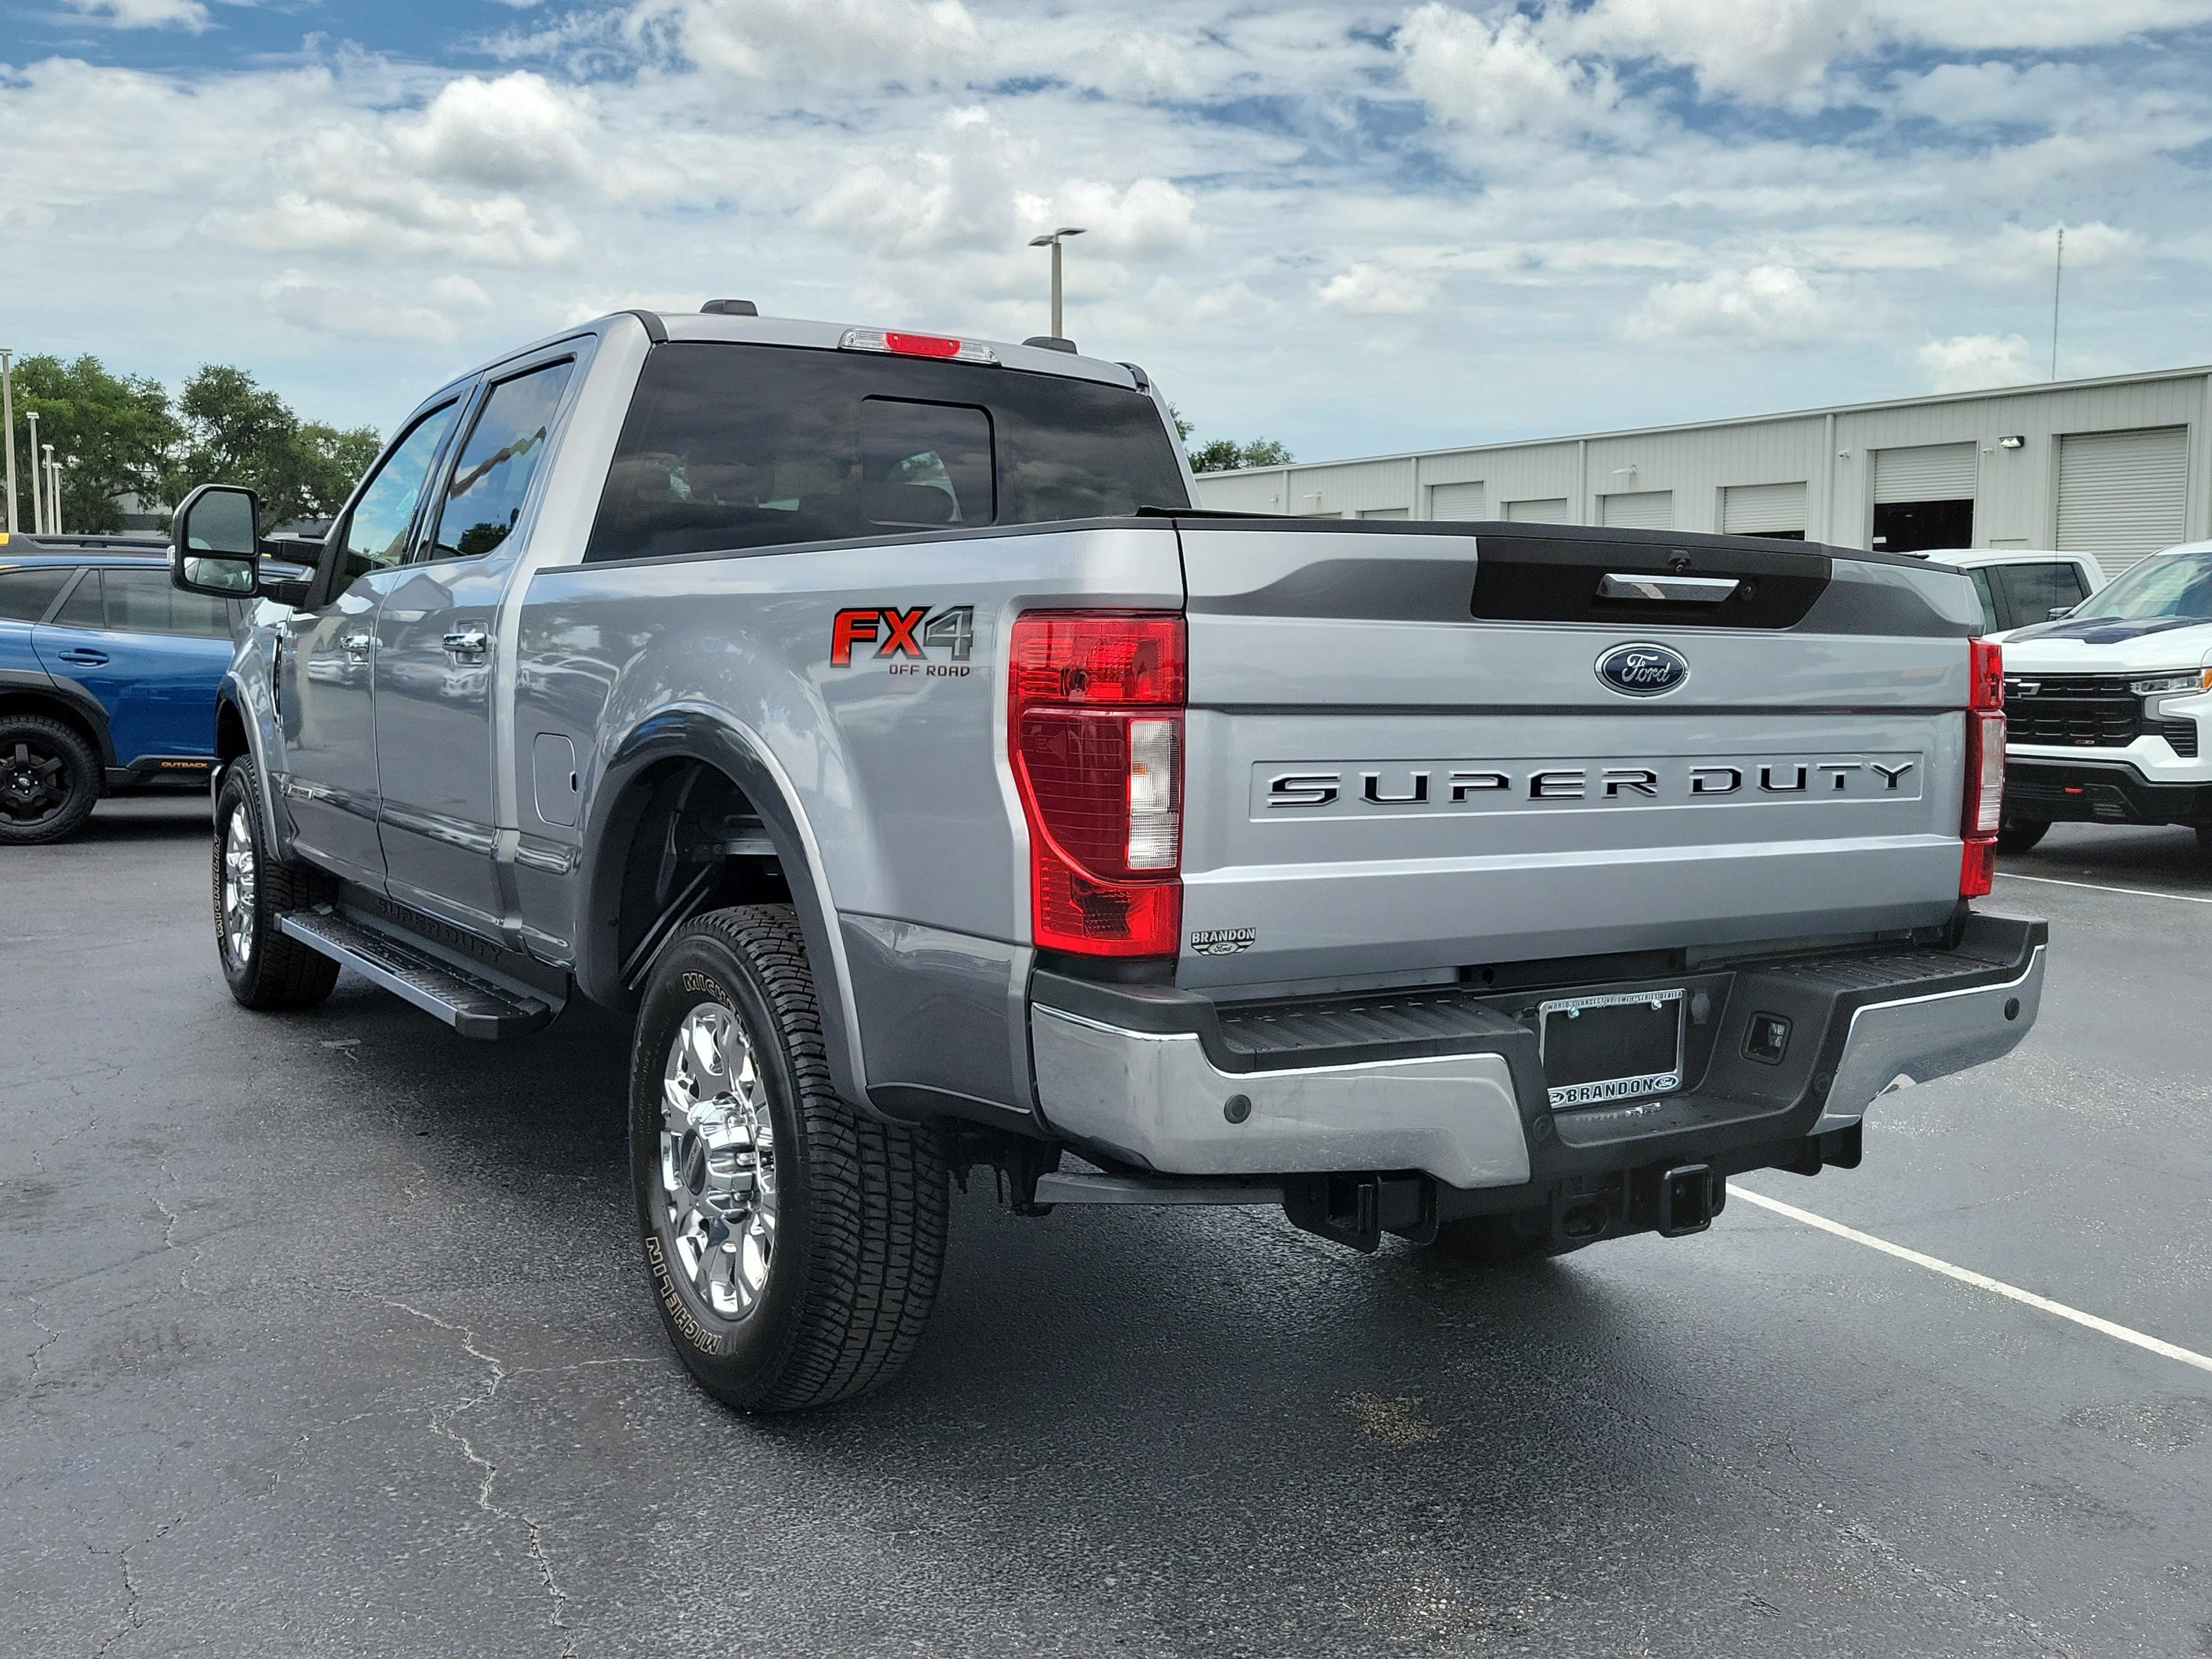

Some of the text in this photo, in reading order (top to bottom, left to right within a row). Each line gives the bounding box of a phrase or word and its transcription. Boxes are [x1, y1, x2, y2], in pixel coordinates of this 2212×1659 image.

[830, 605, 974, 668] FX4
[889, 664, 970, 677] OFF ROAD
[1622, 653, 1671, 682] Ford
[1266, 761, 1915, 808] SUPER DUTY
[212, 833, 224, 938] MICHELIN
[1192, 928, 1255, 944] BRANDON
[1214, 943, 1232, 953] Ford
[1577, 998, 1604, 1007] LARGEST
[1660, 991, 1681, 999] DEALER
[1566, 1077, 1654, 1103] BRANDON
[1658, 1078, 1674, 1087] Ford
[645, 1237, 723, 1355] MICHELIN
